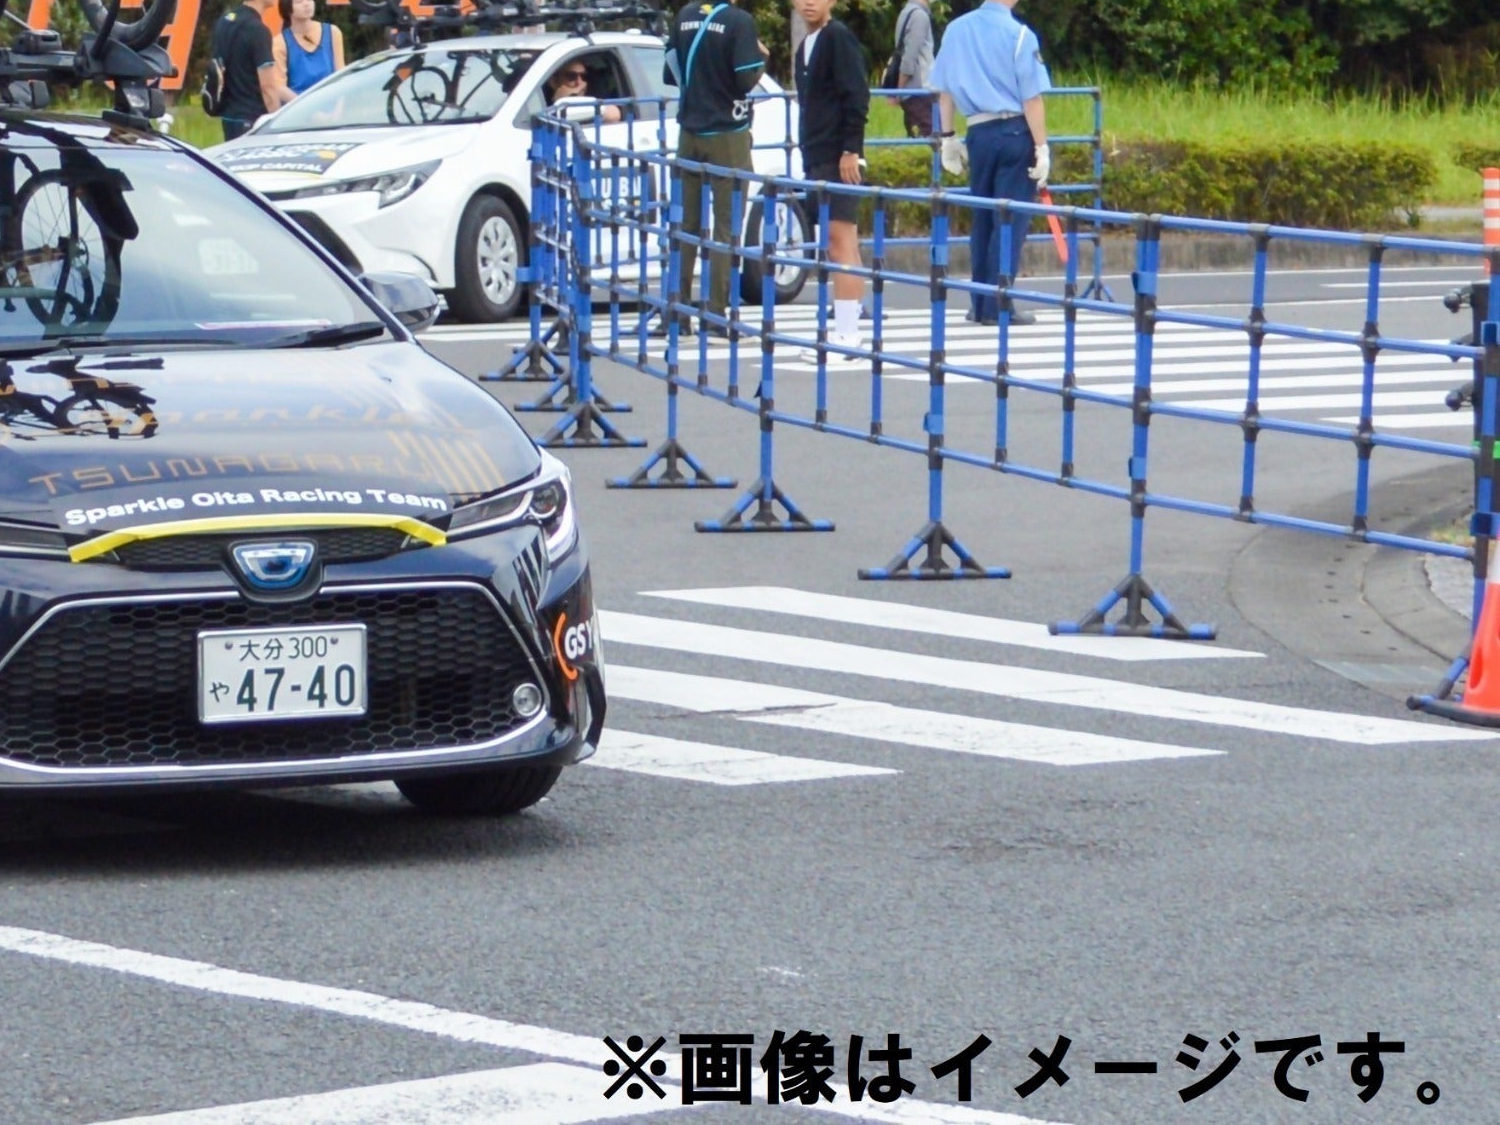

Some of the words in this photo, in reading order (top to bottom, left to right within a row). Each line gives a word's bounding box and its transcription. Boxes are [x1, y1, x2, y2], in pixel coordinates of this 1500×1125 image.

[64, 494, 186, 527] Sparkle
[191, 489, 255, 509] Oita
[262, 488, 362, 507] Racing
[365, 489, 449, 513] Team
[239, 638, 284, 662] 大分
[288, 635, 328, 659] 300
[209, 682, 230, 703] や
[236, 663, 356, 712] 47-40
